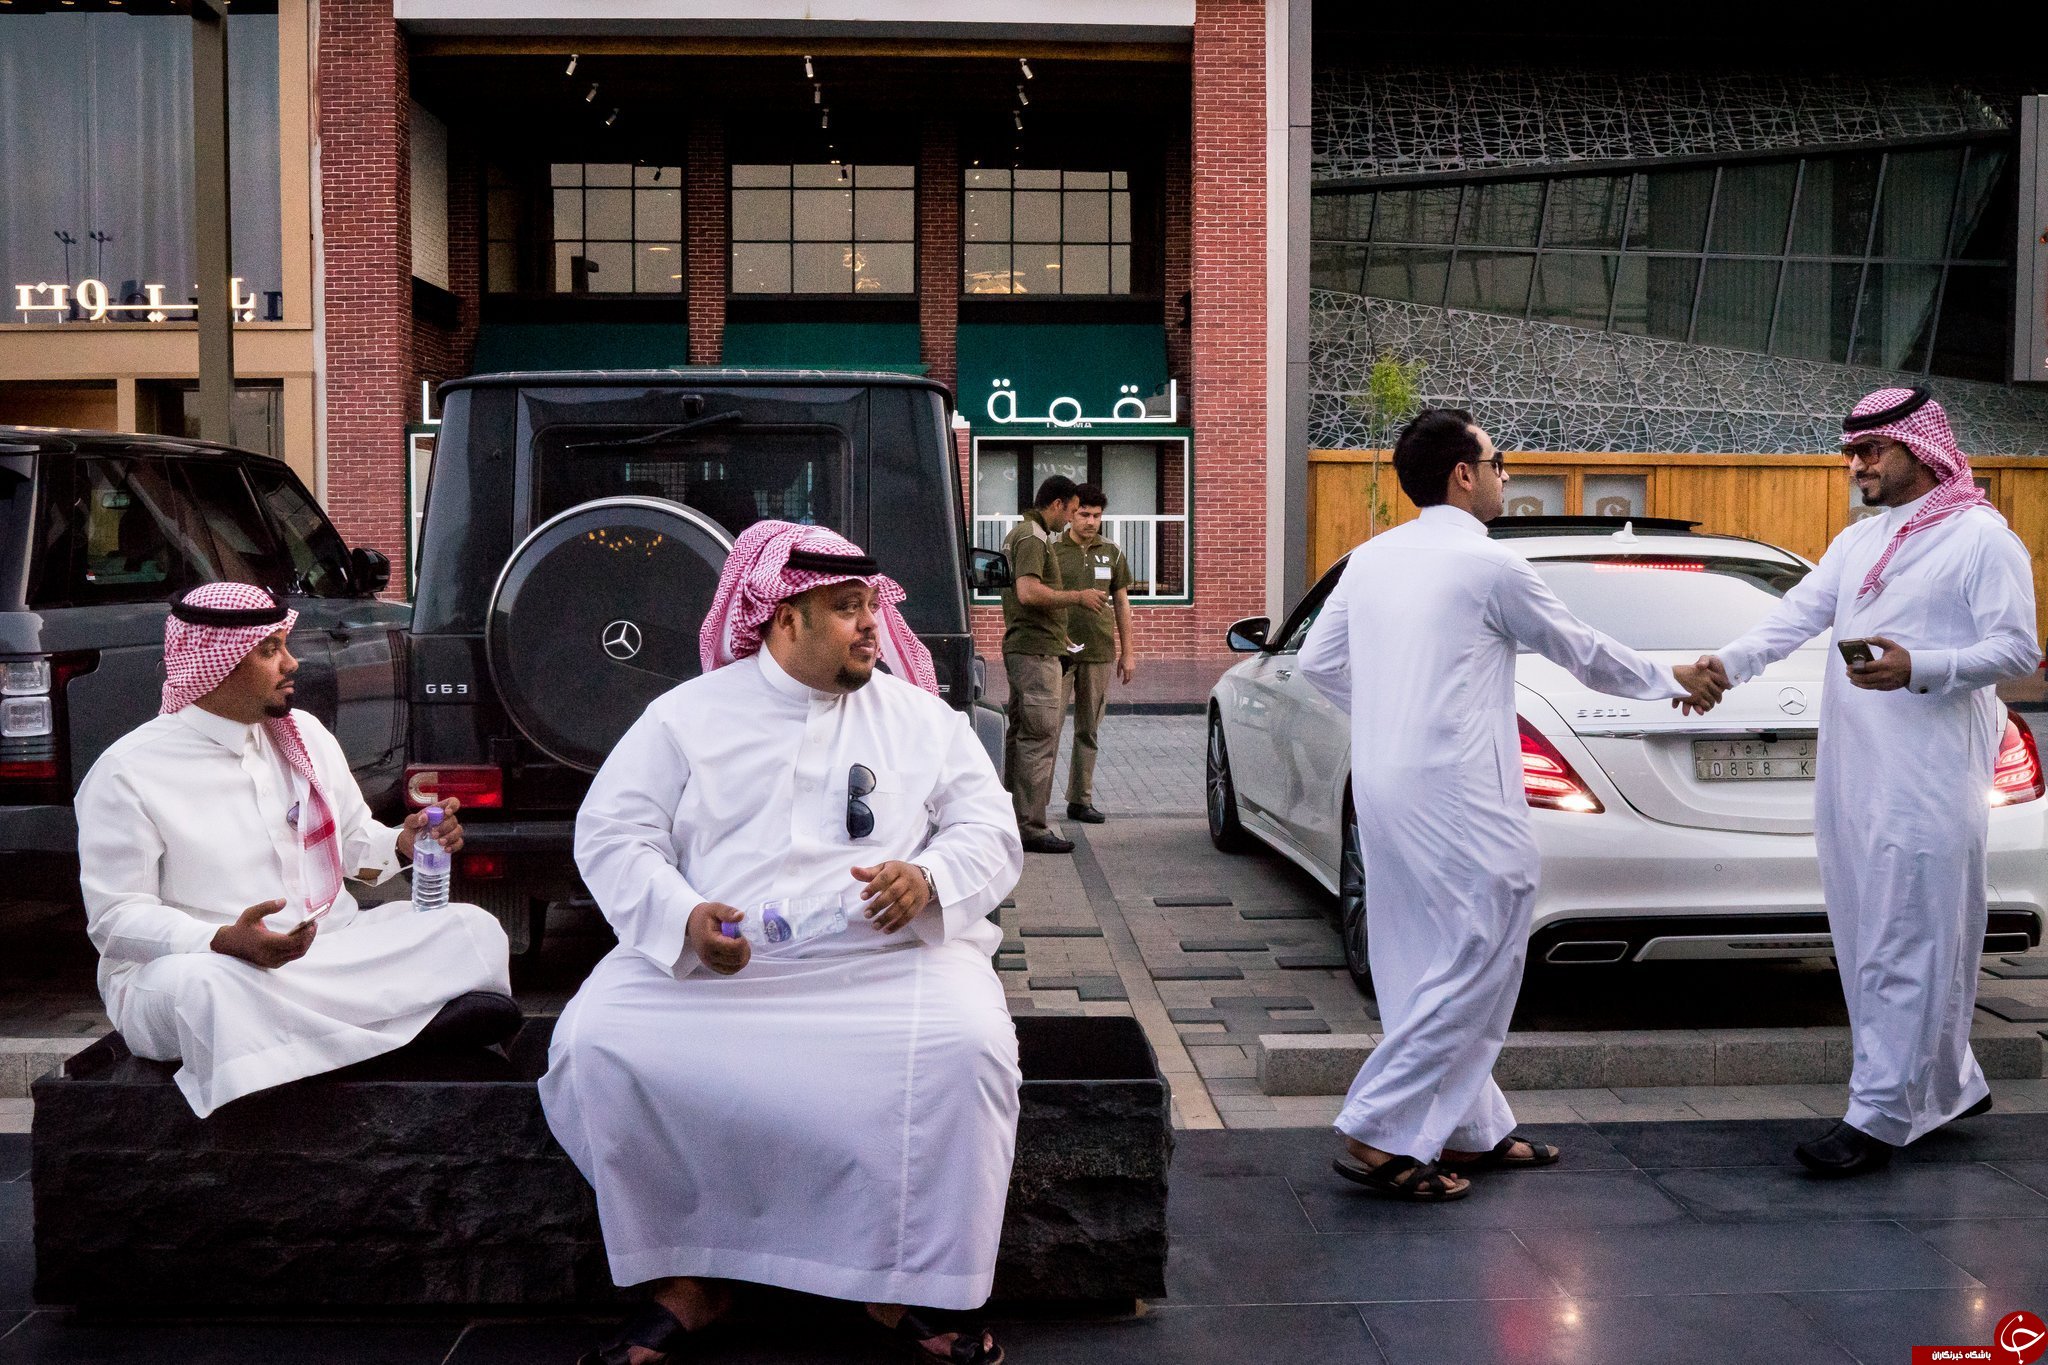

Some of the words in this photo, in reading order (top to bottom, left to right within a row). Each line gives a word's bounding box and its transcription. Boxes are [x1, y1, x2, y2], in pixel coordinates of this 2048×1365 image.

[987, 378, 1177, 427] لقمة
[425, 684, 468, 694] G63
[1713, 761, 1771, 777] 0858
[1800, 760, 1809, 775] K
